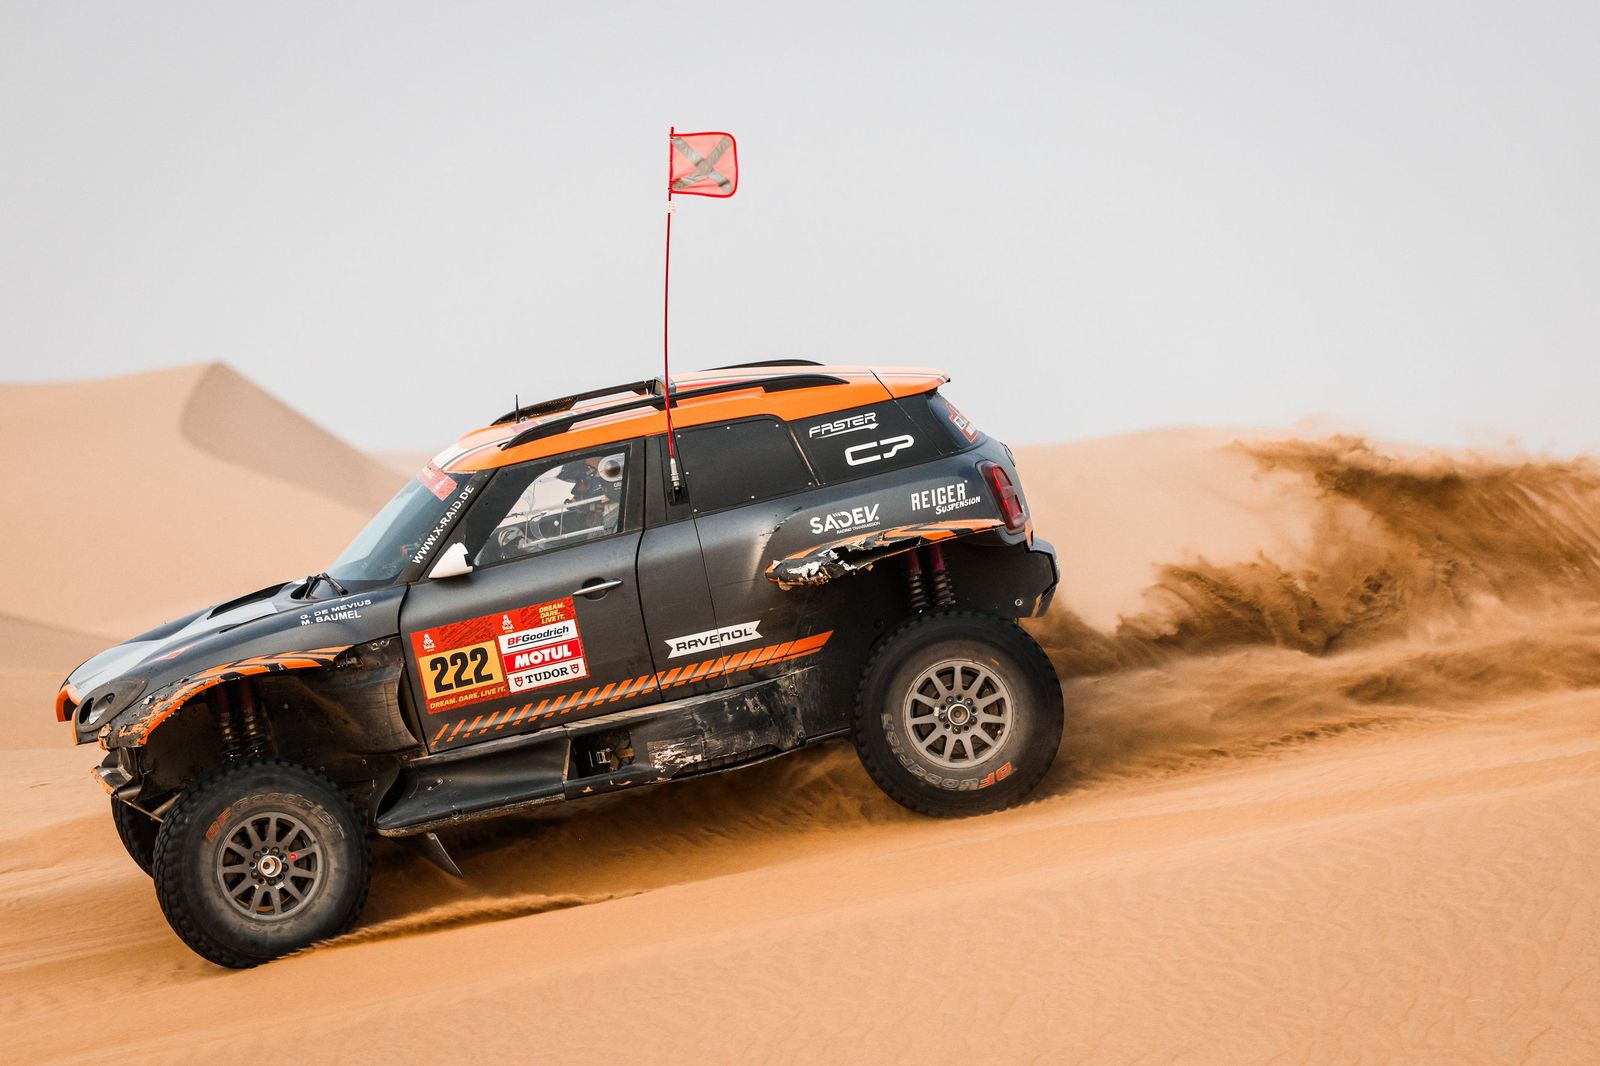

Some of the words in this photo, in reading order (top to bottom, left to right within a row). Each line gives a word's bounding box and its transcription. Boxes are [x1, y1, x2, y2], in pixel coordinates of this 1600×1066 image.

[809, 412, 876, 438] FASTER
[911, 482, 966, 511] REIGER
[412, 485, 475, 564] WWW.X-RAID.DE
[314, 608, 328, 617] DE
[331, 599, 372, 612] MEVIUS
[315, 609, 361, 623] BAUMEL
[539, 602, 565, 613] DREAM.
[507, 625, 569, 646] BFGoodrich
[514, 644, 572, 669] MOTUL
[430, 647, 493, 693] 222
[525, 666, 569, 684] TUDOR
[430, 697, 457, 709] DREAM.
[458, 692, 479, 702] DARE.
[480, 687, 497, 697] LIVE
